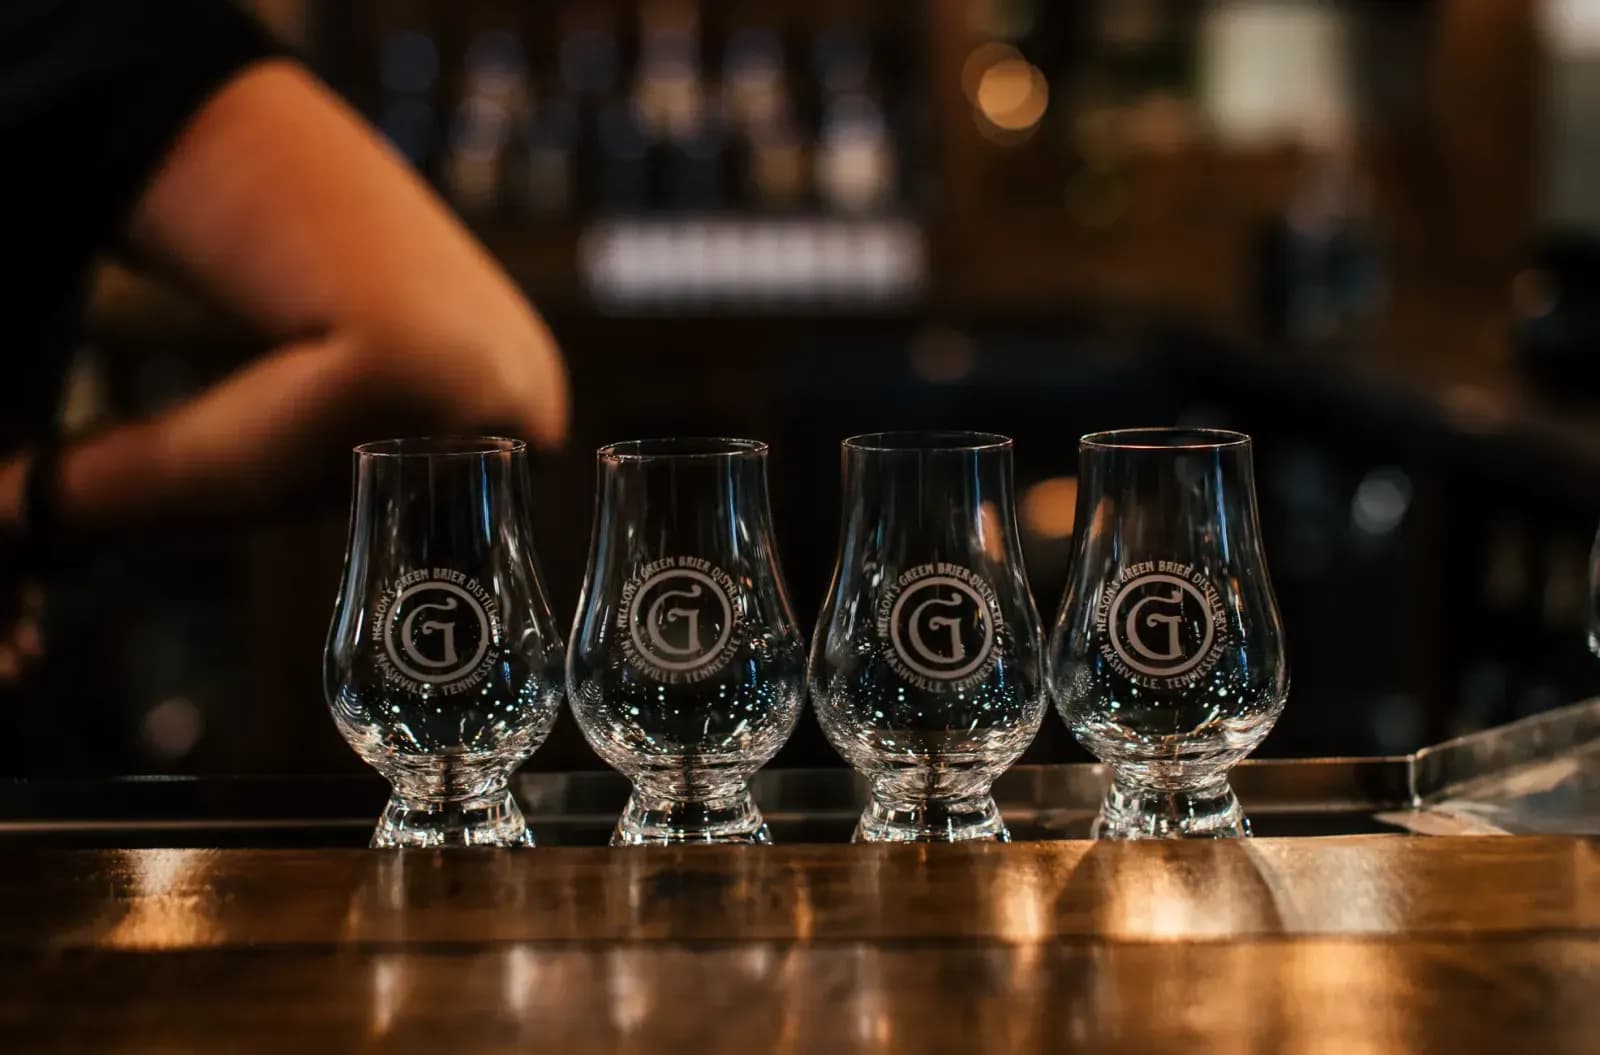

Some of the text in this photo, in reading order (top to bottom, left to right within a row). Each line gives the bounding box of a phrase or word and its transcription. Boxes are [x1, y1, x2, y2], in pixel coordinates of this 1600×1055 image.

[641, 558, 675, 580] GREEN
[679, 556, 711, 572] BRIER
[899, 563, 934, 586] GREEN
[938, 563, 970, 579] BRIER
[1120, 561, 1154, 582] GREEN
[1159, 560, 1191, 577] BRIER
[1192, 573, 1228, 632] DISTILLERY
[395, 568, 429, 589] GREEN
[433, 568, 466, 584] BRIER
[466, 579, 502, 641] DISTILL
[401, 597, 458, 667] G
[647, 584, 702, 654] G
[909, 593, 964, 663] G
[1126, 590, 1182, 660] G
[443, 652, 500, 696] TENNESSEE
[685, 637, 741, 684] TENNESSEE
[1167, 643, 1225, 689] TENNESSEE
